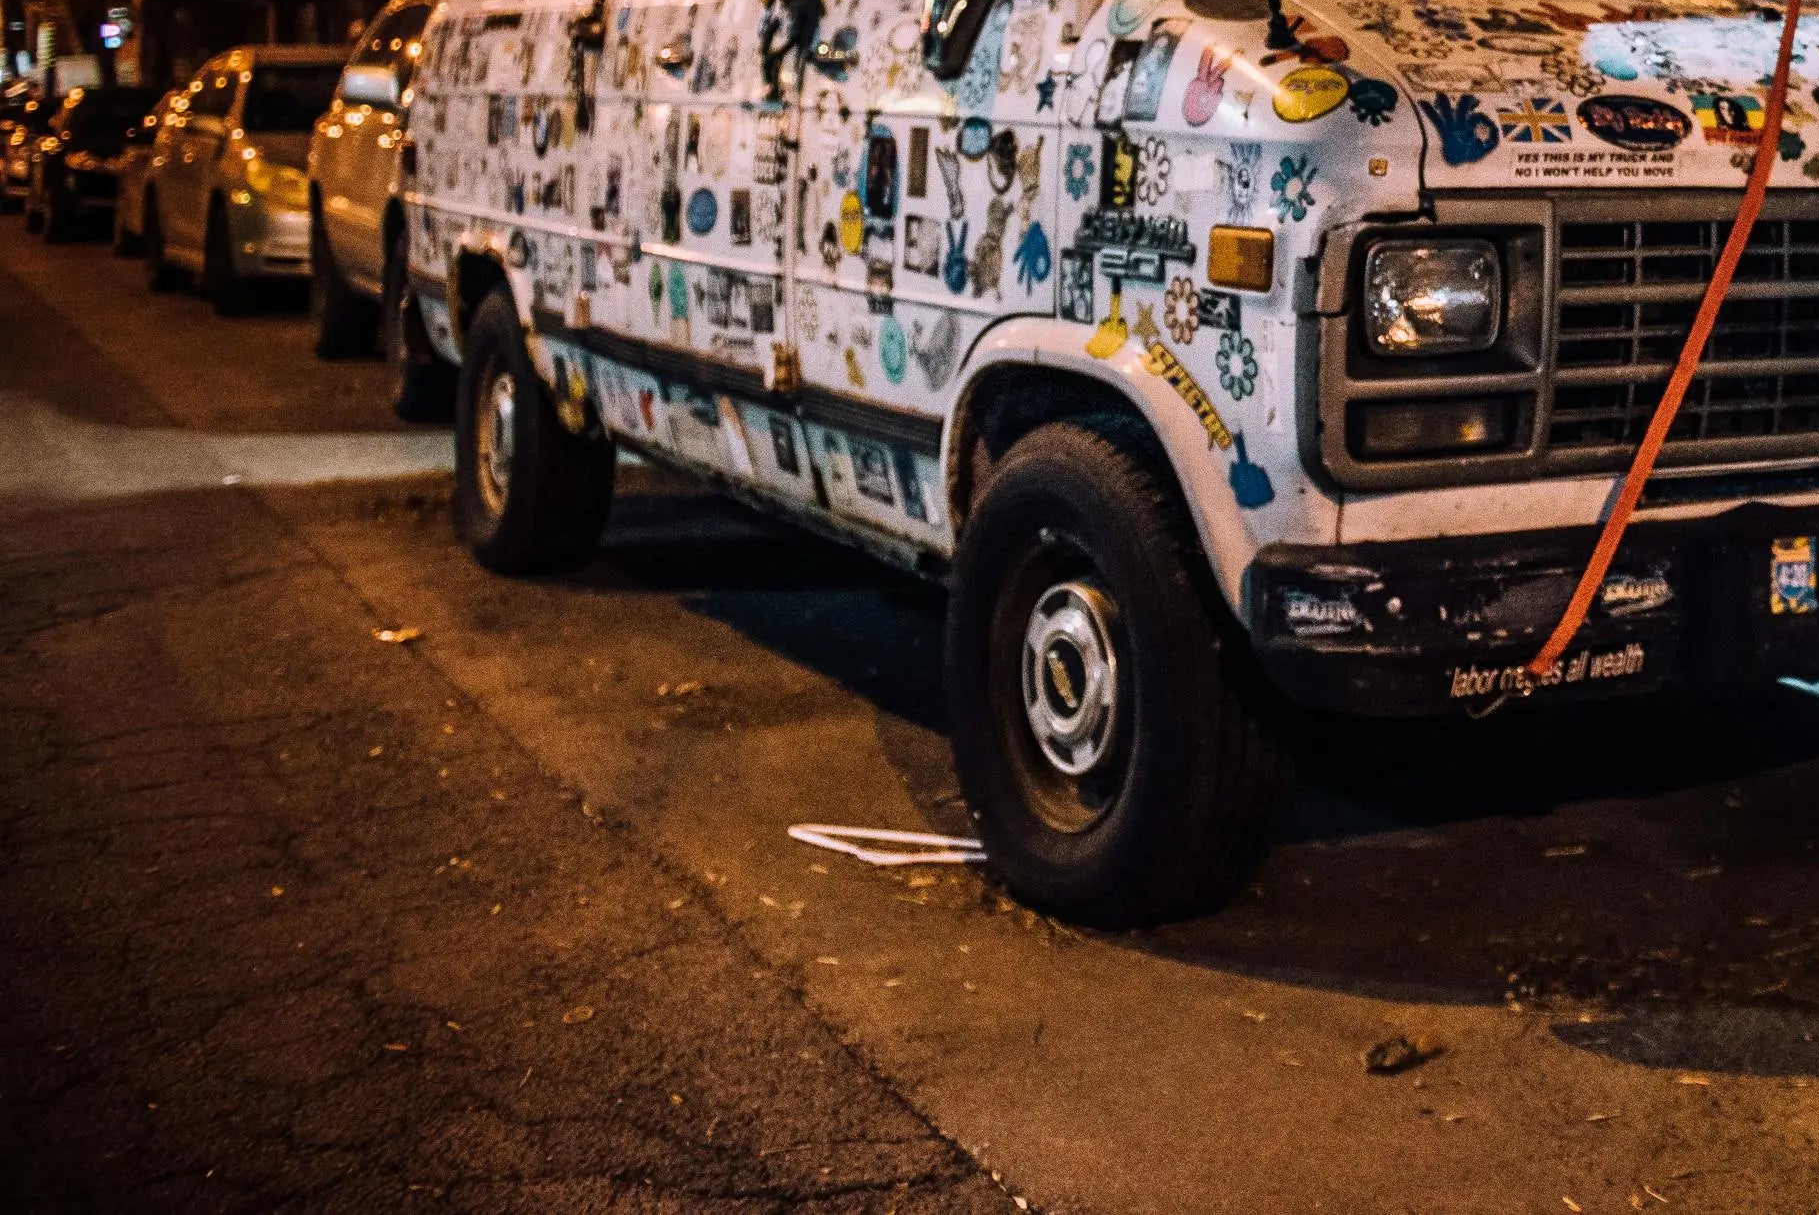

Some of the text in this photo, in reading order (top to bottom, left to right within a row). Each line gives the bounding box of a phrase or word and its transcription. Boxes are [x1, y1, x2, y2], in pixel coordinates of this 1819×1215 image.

[1517, 152, 1674, 164] YES THIS IS MY TRUCK AND
[1515, 167, 1532, 178] NO
[1543, 166, 1579, 178] WON'T
[1583, 167, 1613, 178] HELP
[1617, 167, 1640, 178] YOU
[1643, 167, 1674, 178] MOVE
[1451, 666, 1499, 697] labor
[1566, 650, 1591, 683] all
[1590, 642, 1645, 678] wealth
